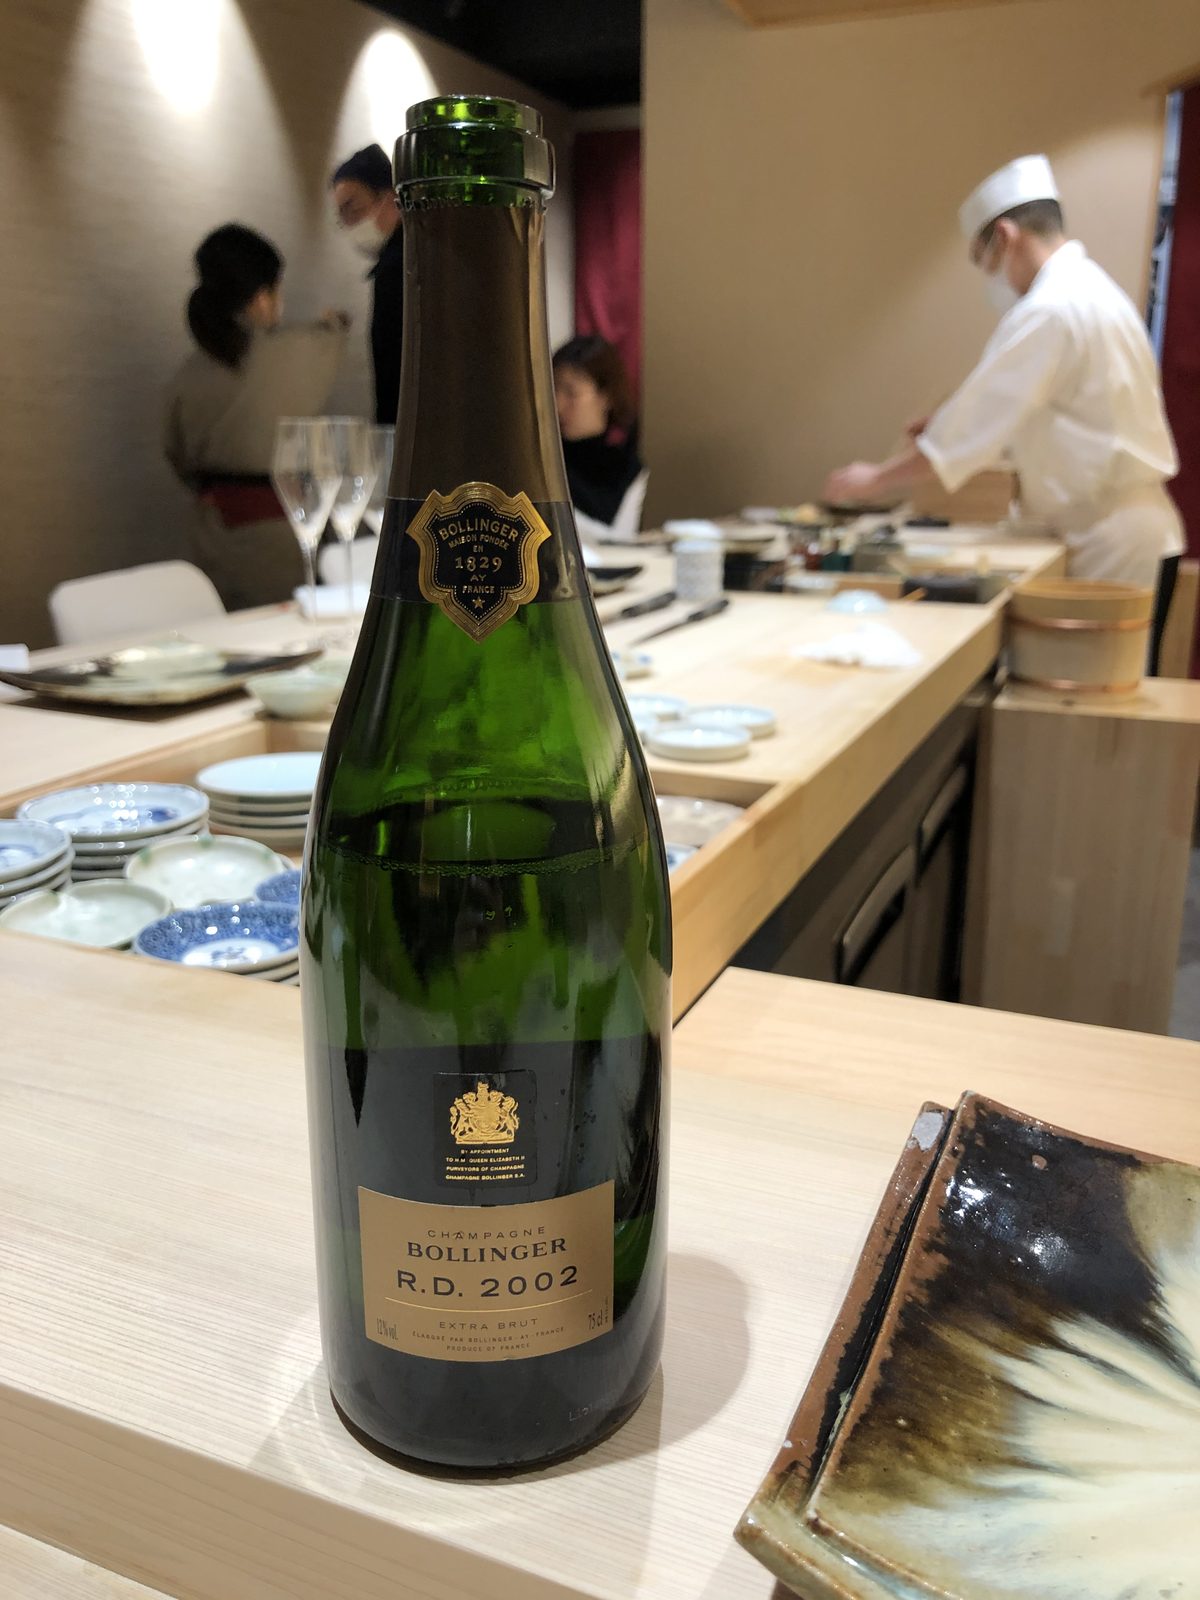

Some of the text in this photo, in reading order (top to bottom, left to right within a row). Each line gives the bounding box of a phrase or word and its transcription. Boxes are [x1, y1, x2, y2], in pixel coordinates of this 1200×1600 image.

[439, 518, 519, 542] BOLLINGER
[455, 556, 502, 572] 1829
[462, 586, 494, 594] FRANCE
[428, 1226, 545, 1240] CHAMPAGNE
[408, 1238, 566, 1262] BOLLINGER
[397, 1265, 577, 1297] R.D. 2002
[440, 1318, 538, 1330] EXTRA BRUT
